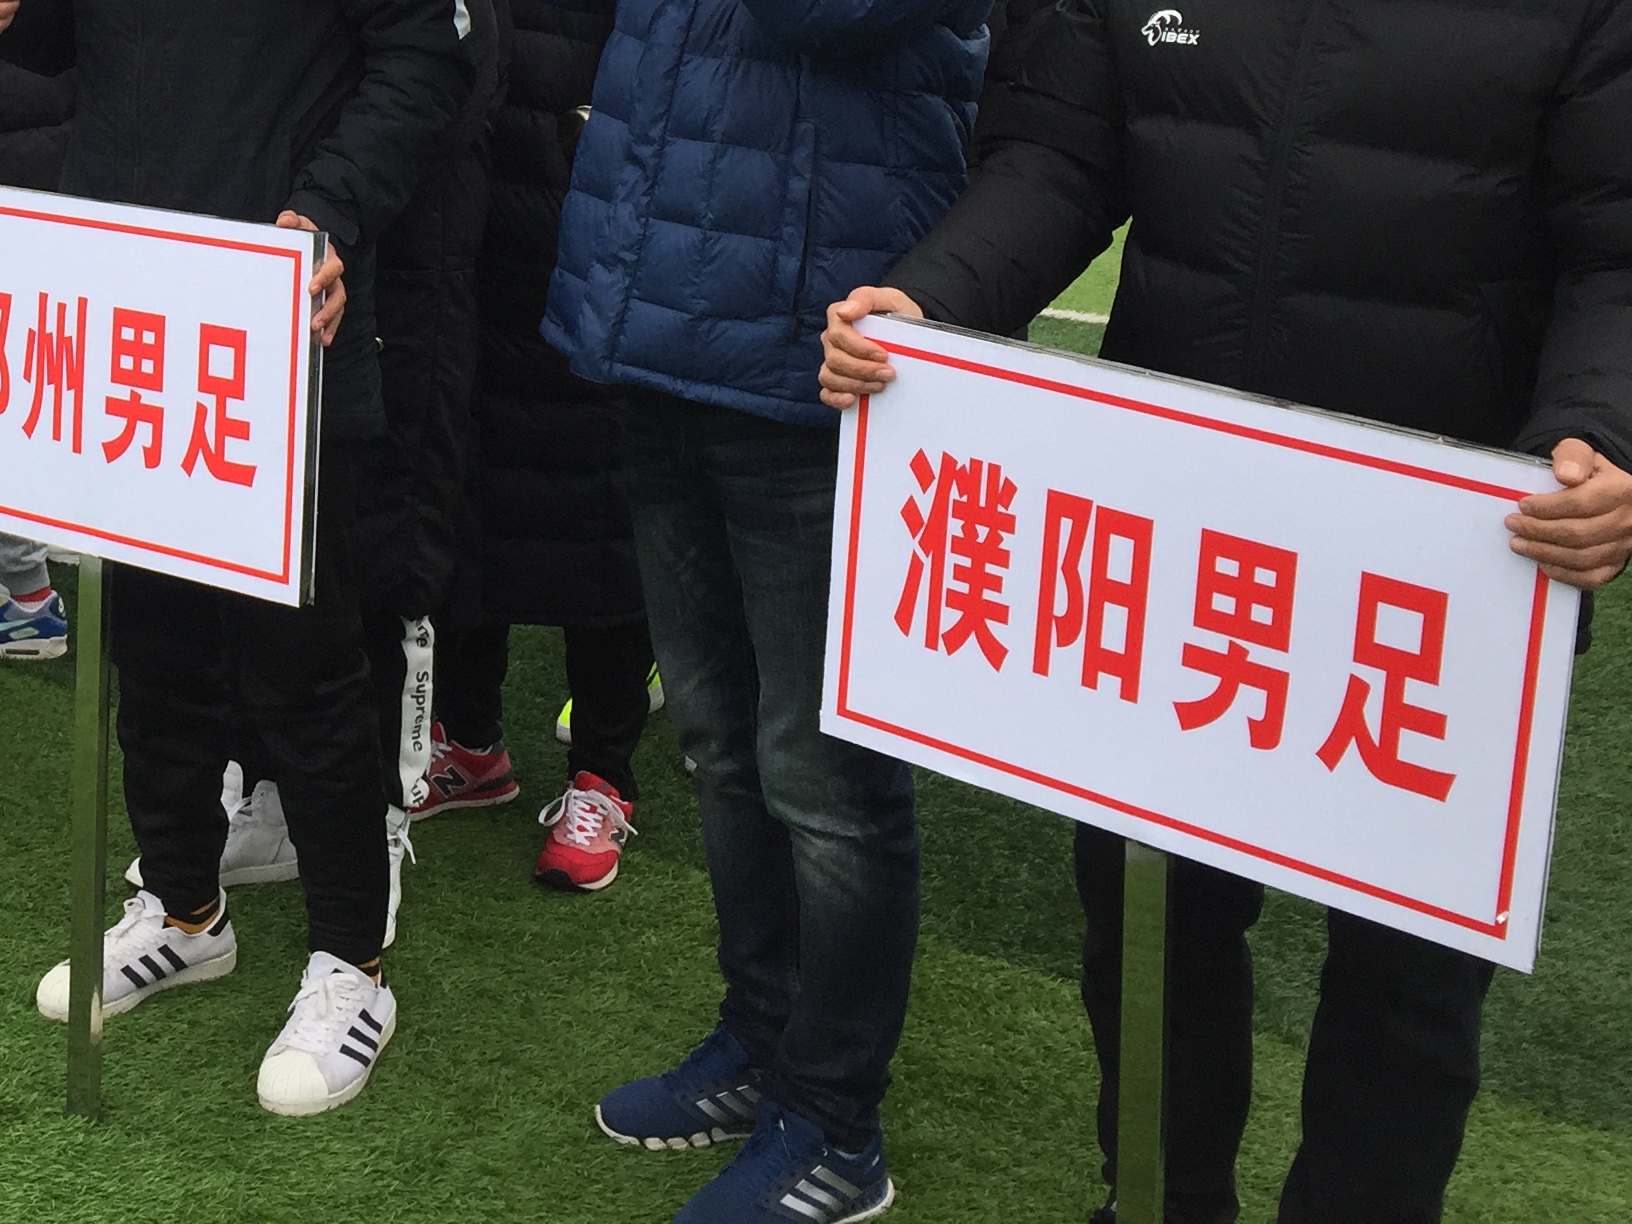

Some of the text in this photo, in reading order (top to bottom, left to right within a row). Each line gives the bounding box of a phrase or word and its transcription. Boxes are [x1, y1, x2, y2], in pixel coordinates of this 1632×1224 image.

[1161, 32, 1200, 45] IBEX
[894, 447, 1457, 804] 濮阳男足
[410, 670, 429, 753] Supreme
